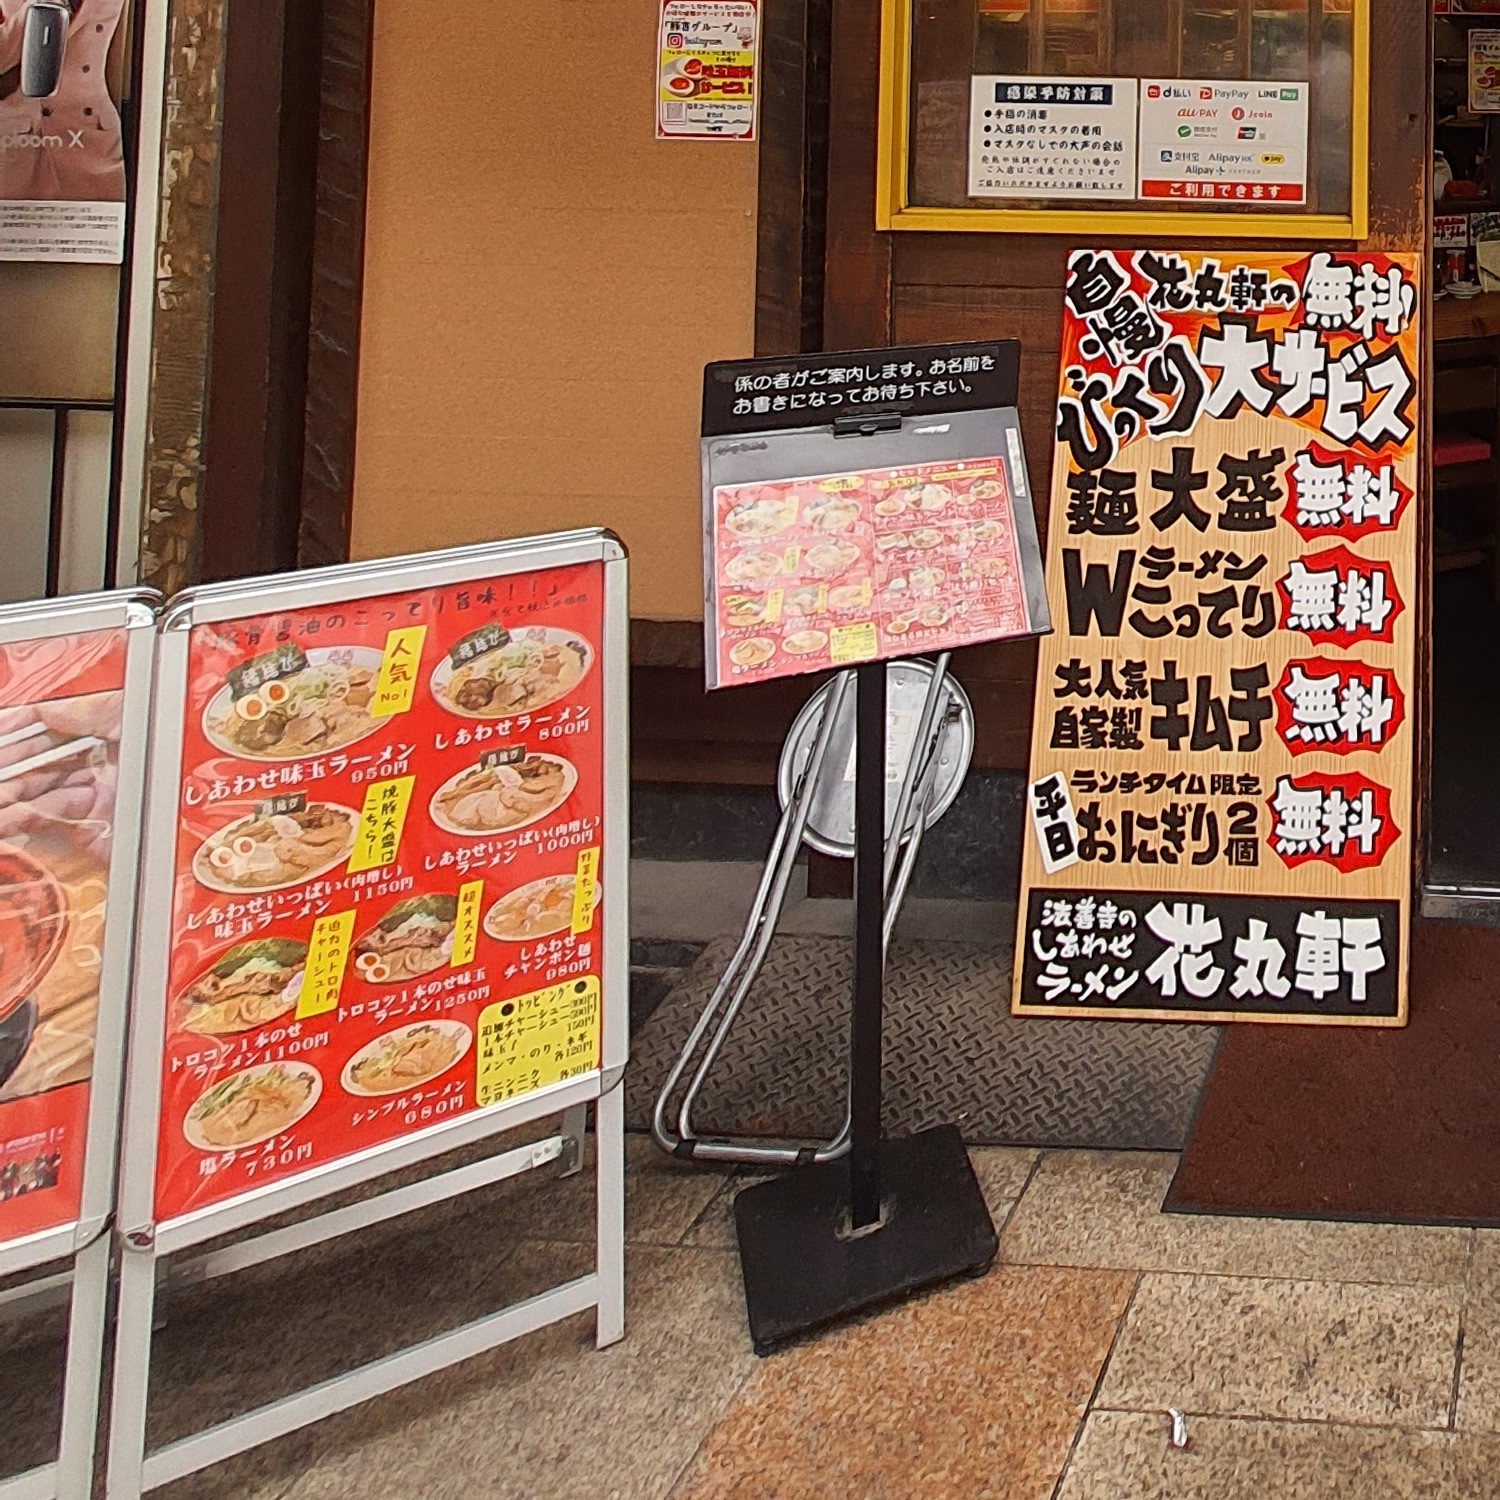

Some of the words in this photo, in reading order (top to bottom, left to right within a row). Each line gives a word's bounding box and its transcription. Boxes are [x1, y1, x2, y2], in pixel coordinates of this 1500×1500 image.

[1007, 86, 1104, 101] 感染予防対策
[1214, 87, 1249, 100] PayPay
[1258, 90, 1277, 98] LINE
[68, 130, 85, 148] X
[994, 124, 1102, 136] 入店時のマスクの着用
[994, 139, 1124, 152] マスクなしでの大声の会話
[1170, 183, 1282, 199] ご利用できます
[734, 354, 996, 393] 係の者がご案内します。お名前を
[733, 379, 972, 415] お書きになってお待ち下さい。
[1295, 453, 1399, 527] 無料
[1139, 545, 1268, 581] ラーメン
[1285, 560, 1392, 632] 無料
[1129, 585, 1278, 638] こってり
[1054, 659, 1149, 700] 大人気
[1150, 660, 1273, 752] キムチ
[1284, 668, 1393, 743] 無料
[435, 705, 591, 750] しあわせラーメン
[538, 719, 590, 740] 800円
[1050, 706, 1144, 750] 自家製
[186, 743, 416, 803] しあわせ味玉ラーメン
[351, 759, 409, 783] 950円
[1033, 776, 1075, 863] 平日
[1273, 776, 1382, 856] 無料
[537, 828, 593, 854] 1000円
[456, 851, 518, 876] ラーメン
[353, 876, 414, 902] 1150円
[214, 900, 332, 939] 味玉ラーメン
[520, 935, 577, 960] しあわせ
[1032, 932, 1134, 961] しあわせ
[1144, 901, 1386, 1002] 花丸軒
[545, 957, 592, 982] 980円
[1037, 964, 1139, 1002] ラーメン
[351, 1080, 468, 1127] シンプルラーメン
[404, 1094, 464, 1125] 680円
[245, 1142, 313, 1177] 730円
